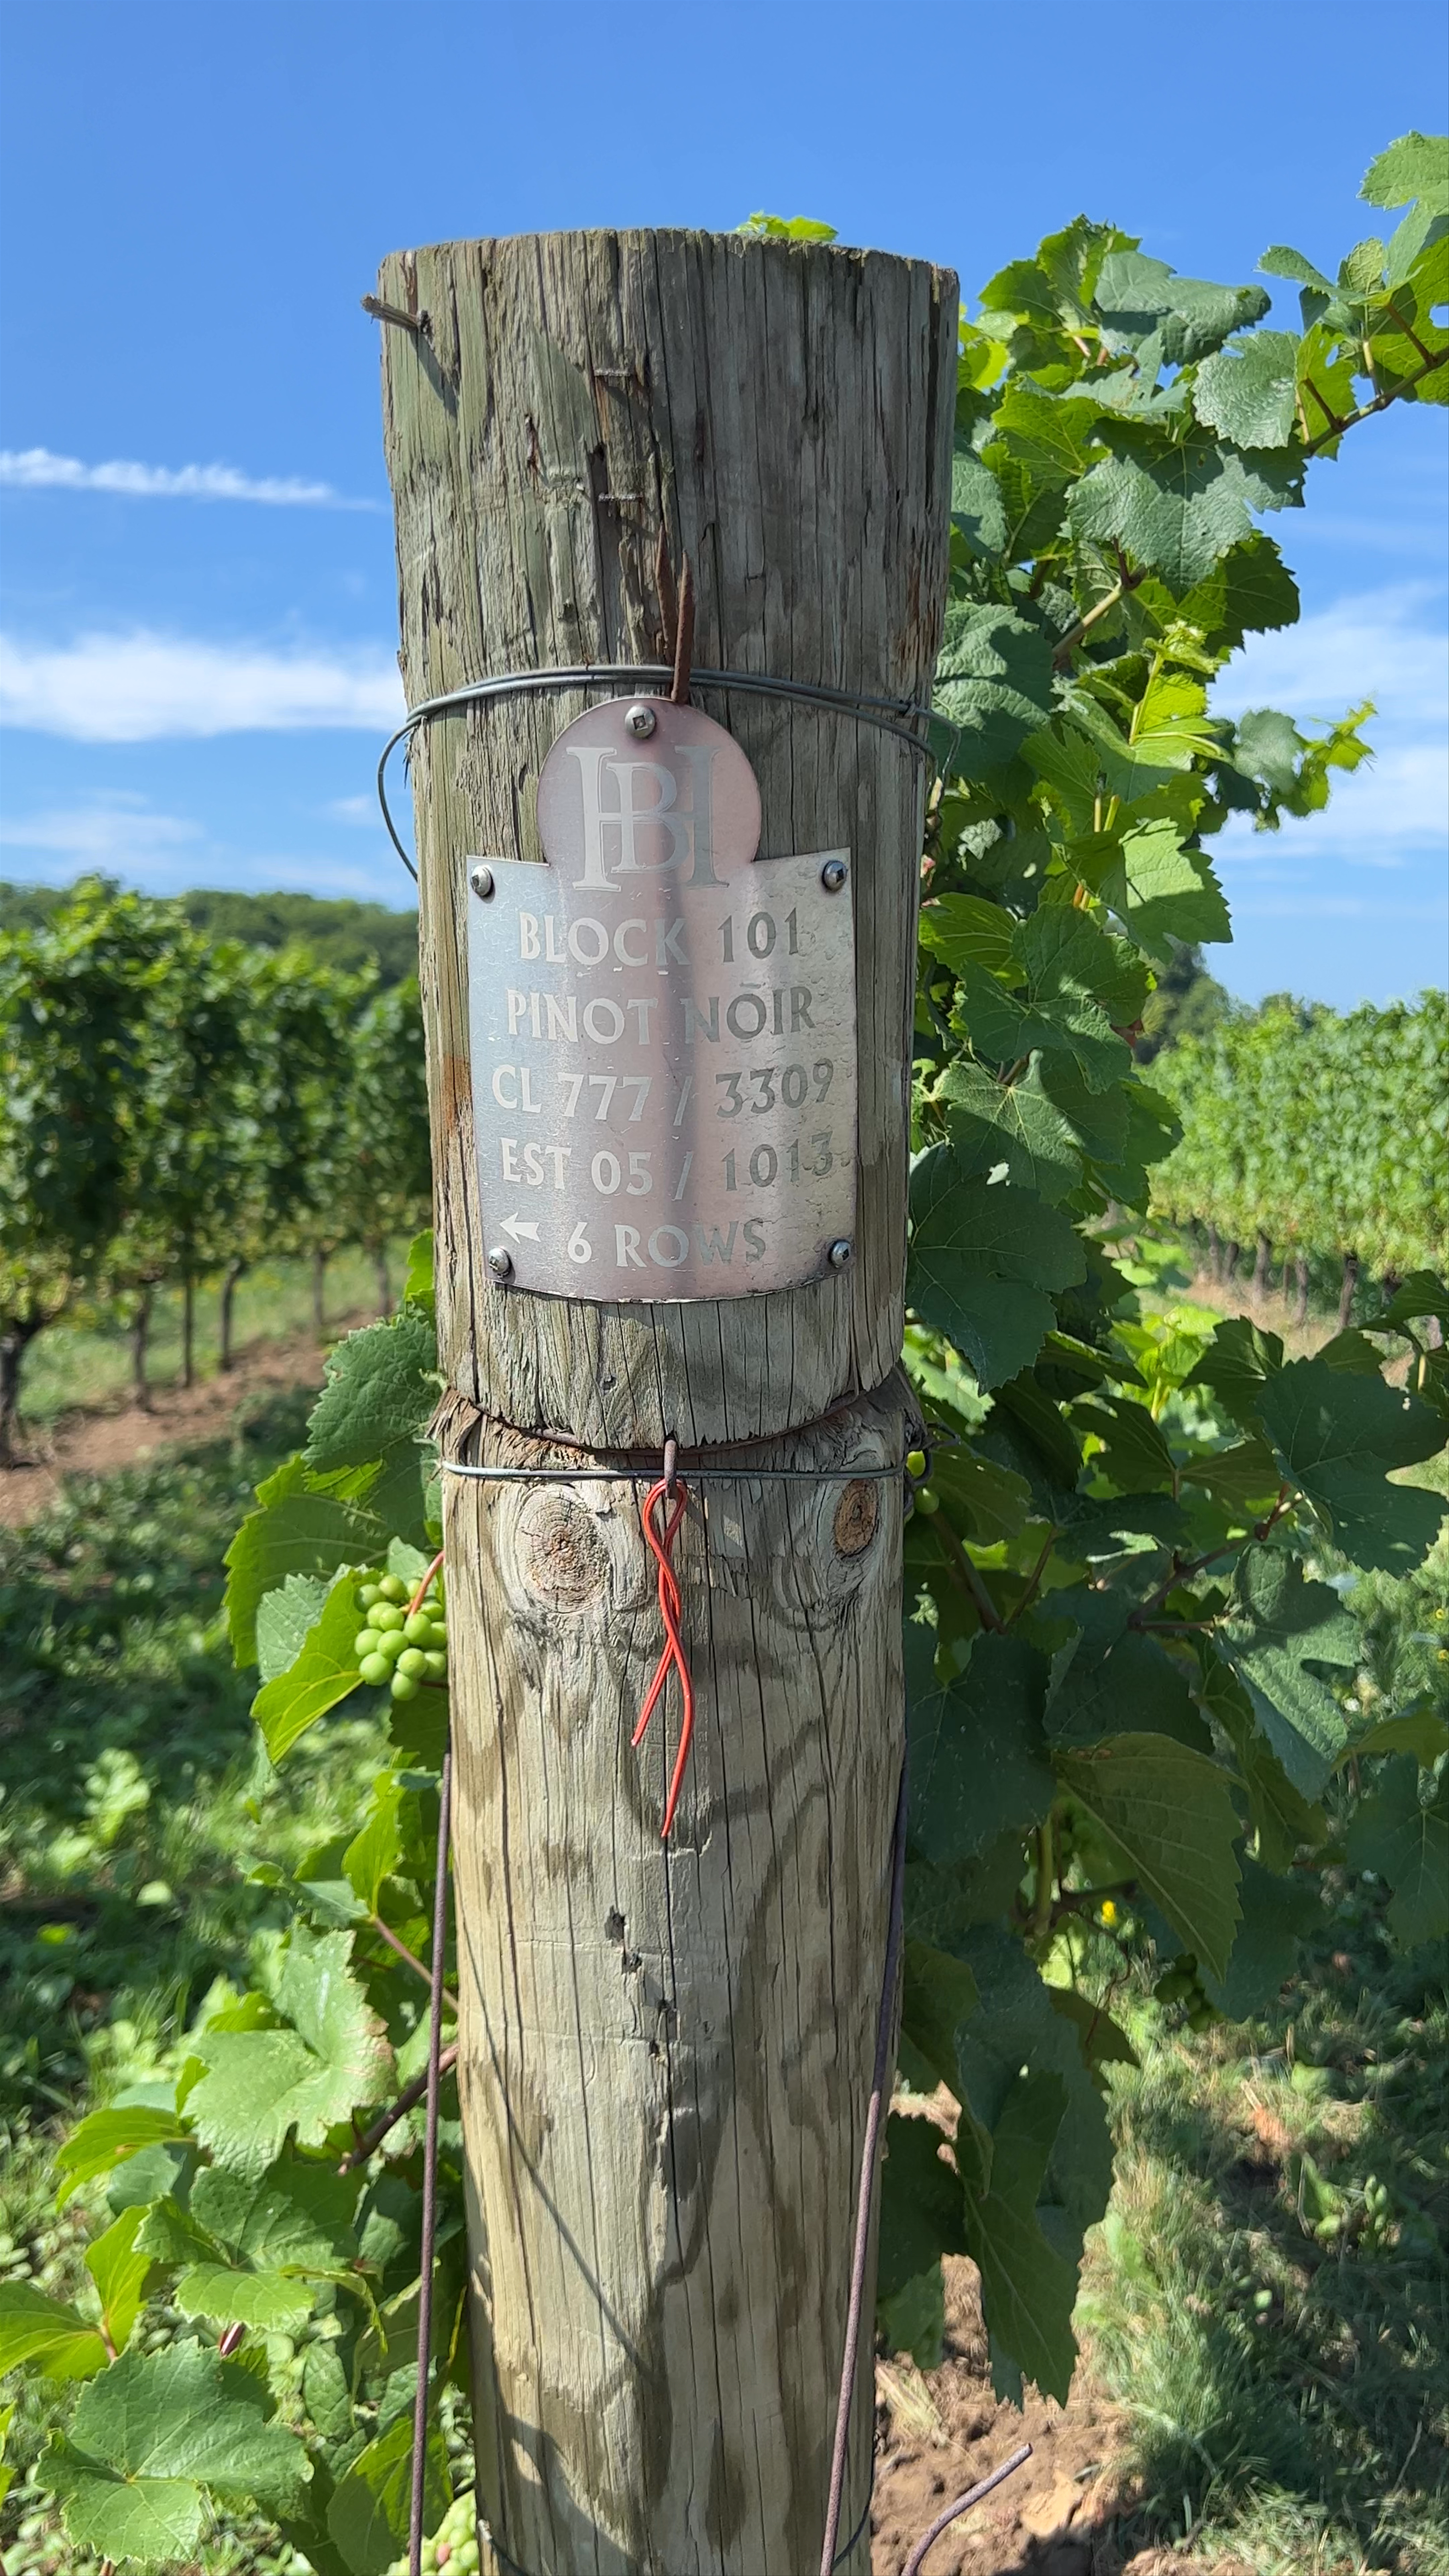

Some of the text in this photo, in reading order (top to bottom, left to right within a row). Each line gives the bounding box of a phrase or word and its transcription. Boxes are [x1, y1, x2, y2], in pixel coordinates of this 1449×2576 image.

[518, 907, 799, 966] BLOCK 101
[507, 986, 817, 1045] PINOT NOIR
[491, 1058, 834, 1126] CL 777 / 3309
[499, 1133, 834, 1200] EST 05 / 1013
[567, 1218, 767, 1268] 6 ROWS
